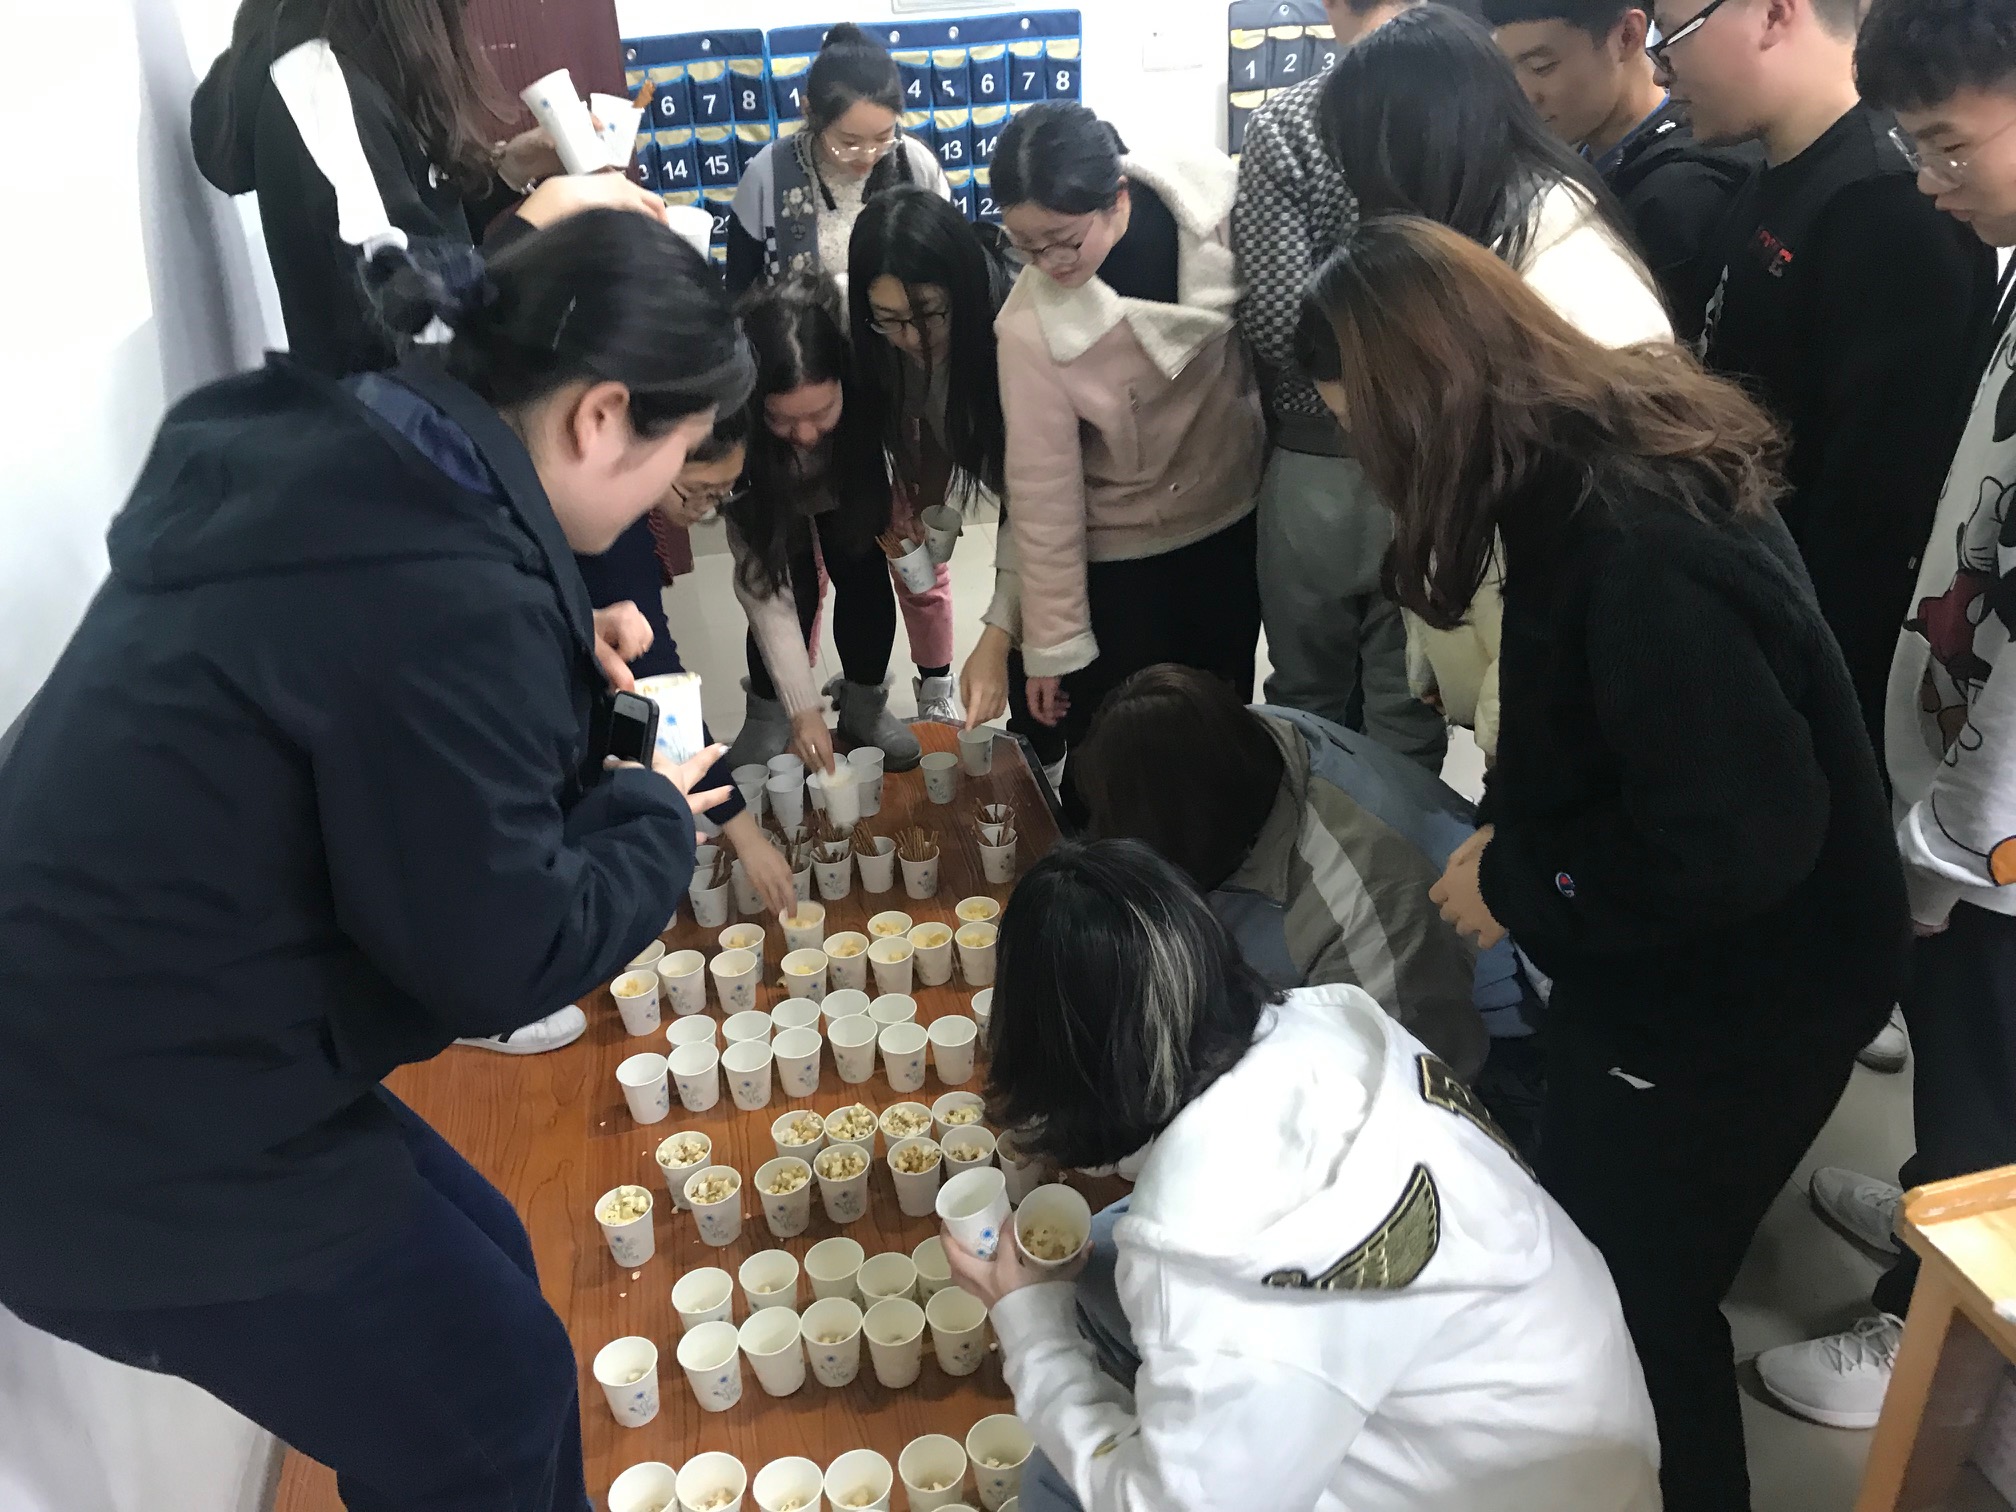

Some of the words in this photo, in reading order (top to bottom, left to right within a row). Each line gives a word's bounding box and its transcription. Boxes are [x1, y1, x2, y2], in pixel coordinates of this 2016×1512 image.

[1245, 60, 1256, 80] 1
[1282, 53, 1298, 72] 2
[1322, 52, 1336, 71] 3
[907, 78, 922, 98] 4
[942, 80, 955, 97] 5
[981, 73, 994, 94] 6
[1022, 72, 1036, 90] 7
[1056, 70, 1070, 90] 8
[661, 96, 676, 116] 6
[702, 94, 716, 114] 7
[742, 90, 756, 110] 8
[940, 140, 962, 161] 13
[638, 164, 649, 181] 3
[662, 159, 688, 180] 14
[704, 154, 730, 176] 15
